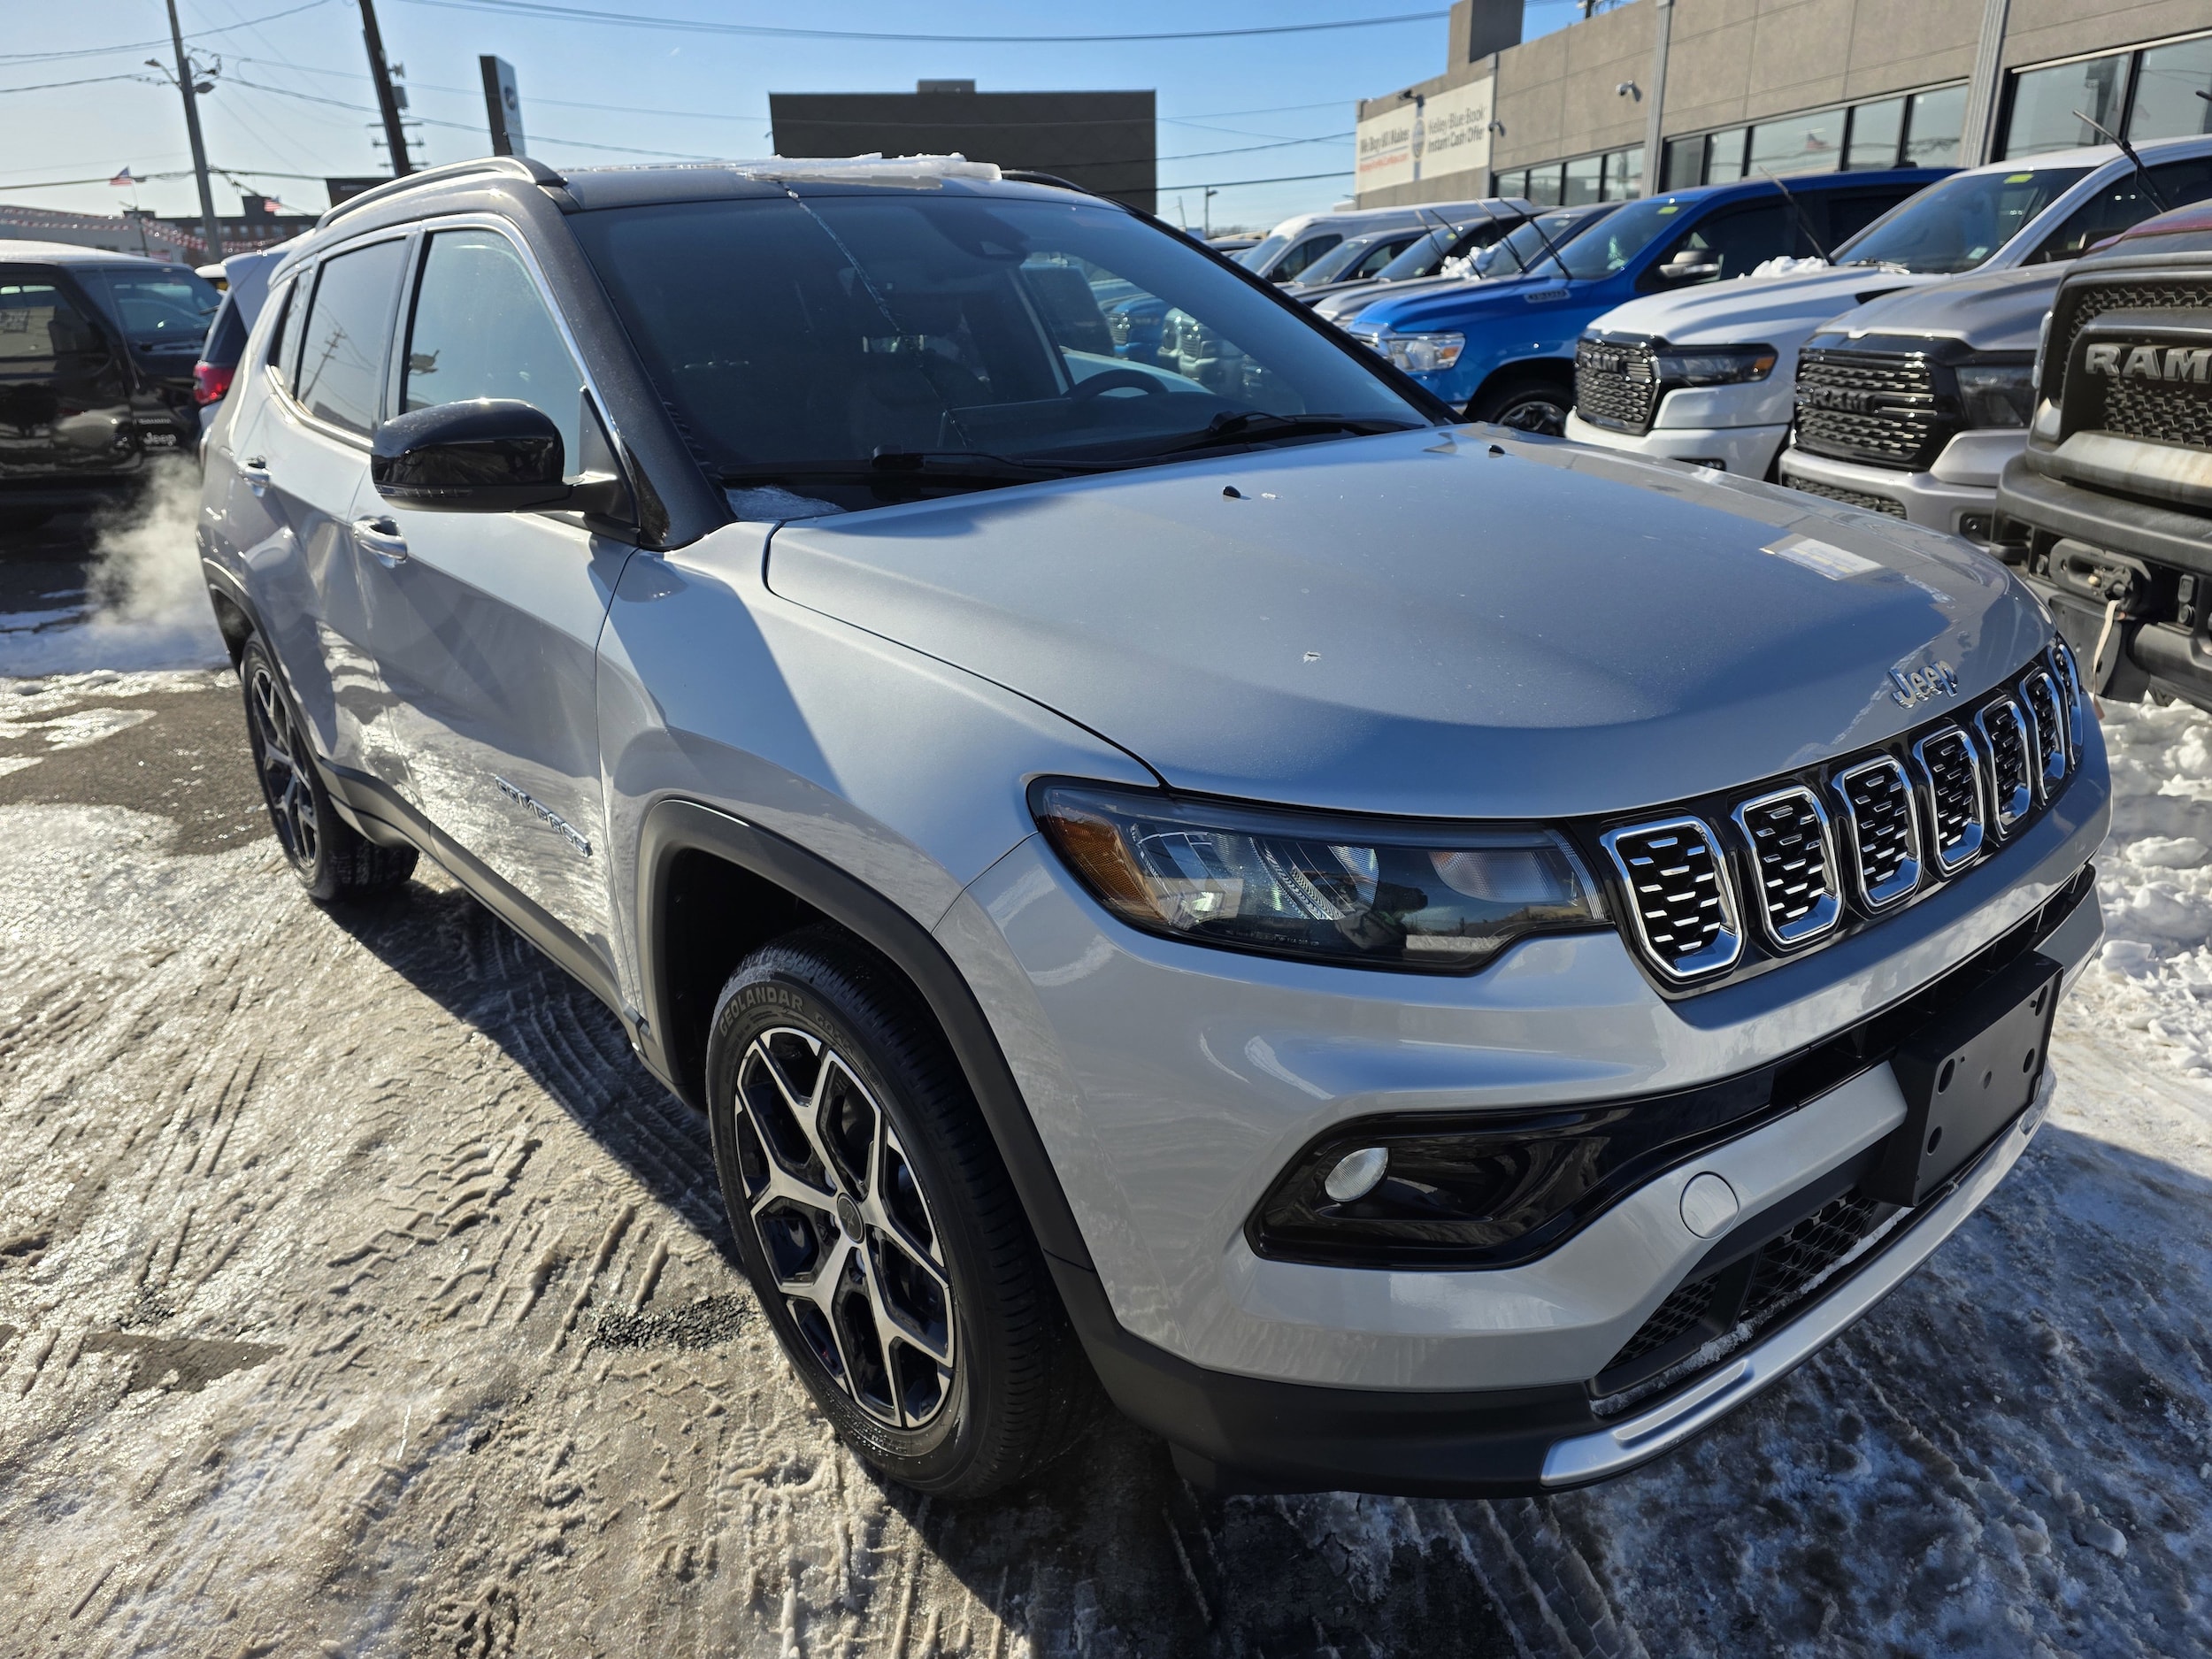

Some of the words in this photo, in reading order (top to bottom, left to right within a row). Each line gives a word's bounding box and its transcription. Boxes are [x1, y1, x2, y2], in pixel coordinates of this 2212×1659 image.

[1449, 112, 1465, 128] Blue
[1428, 134, 1449, 153] Instant
[1450, 129, 1467, 148] Cash
[2085, 342, 2212, 383] RAM
[1812, 388, 1874, 413] RAM
[142, 432, 177, 447] Jeep
[1887, 660, 1959, 710] Jeep
[495, 775, 594, 858] COMPASS
[719, 986, 805, 1038] GEOLANDAR
